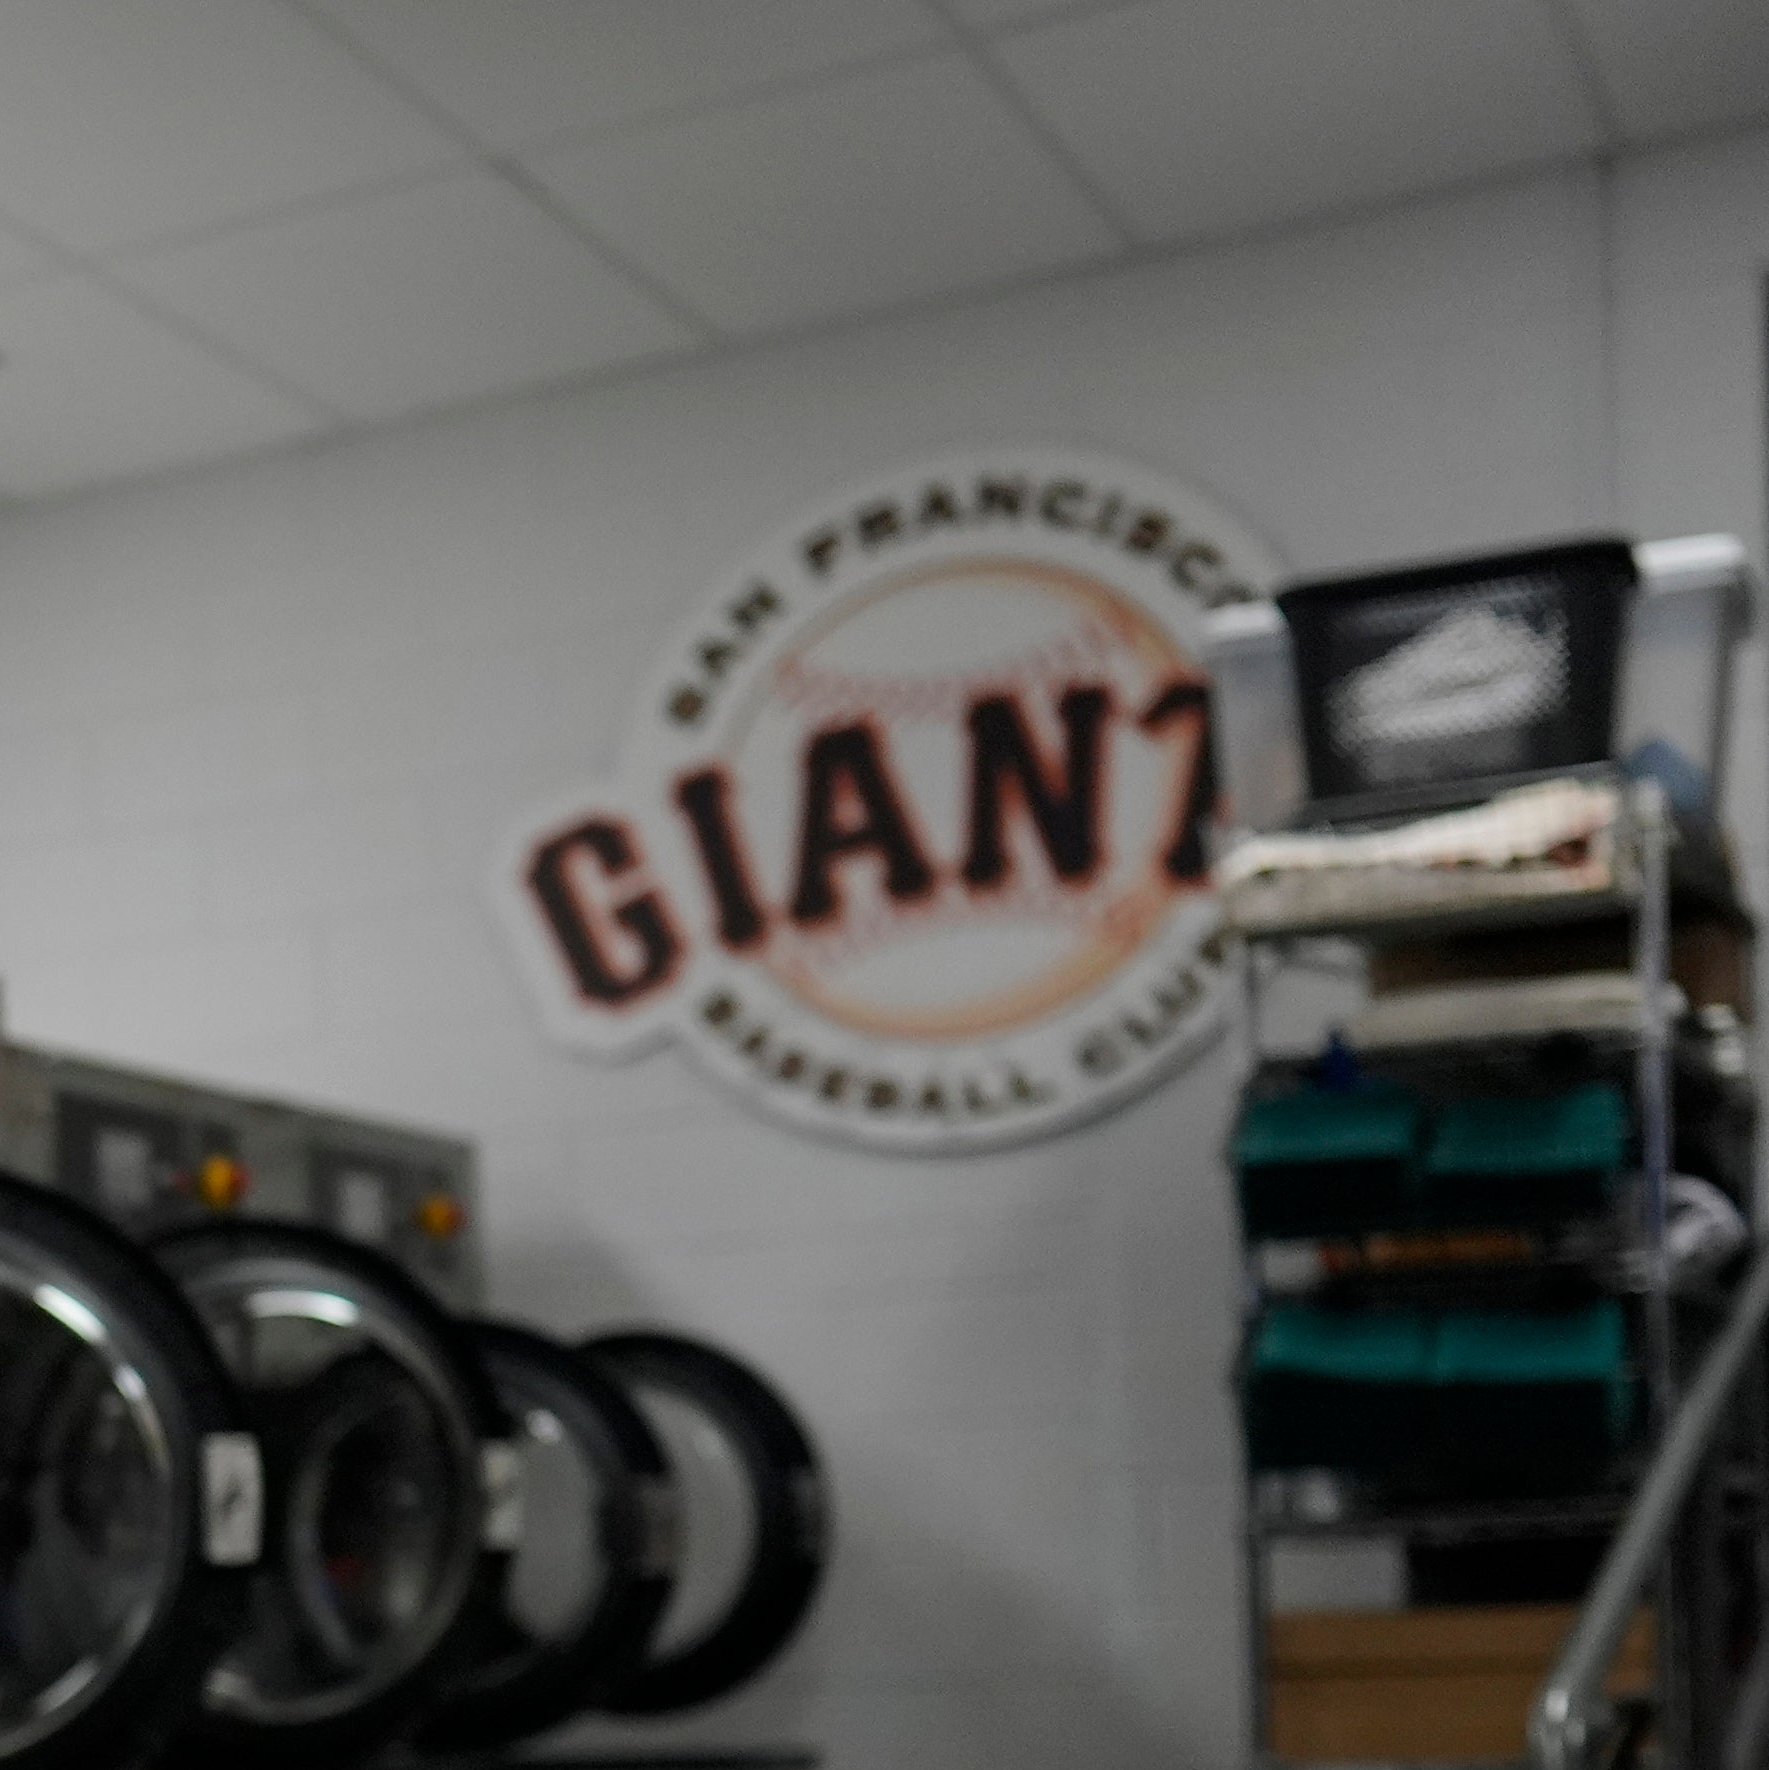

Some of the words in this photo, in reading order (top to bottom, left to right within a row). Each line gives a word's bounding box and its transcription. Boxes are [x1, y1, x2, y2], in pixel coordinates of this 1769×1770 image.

[664, 578, 787, 728] SAN
[523, 672, 1227, 1010] GIANT
[692, 986, 1059, 1120] BASEBALL
